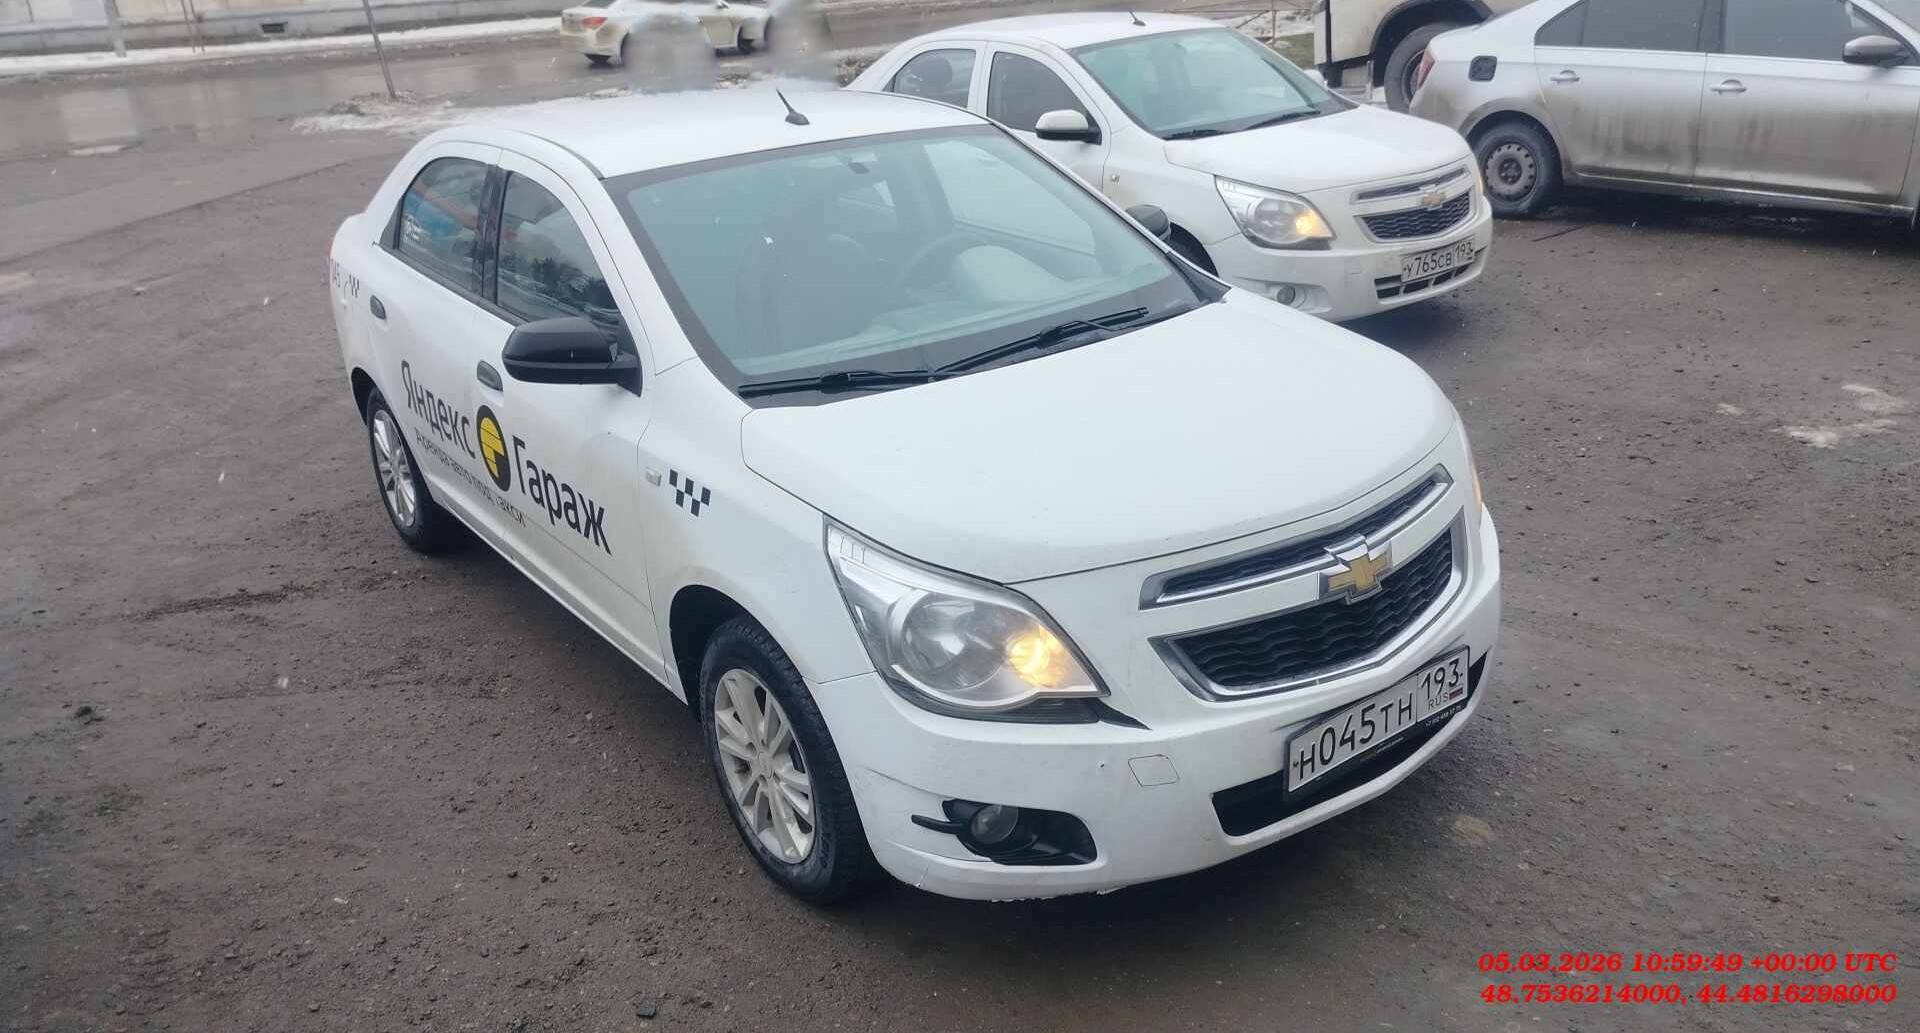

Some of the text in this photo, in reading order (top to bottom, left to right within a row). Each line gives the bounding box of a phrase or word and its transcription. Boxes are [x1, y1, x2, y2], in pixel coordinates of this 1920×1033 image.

[401, 360, 612, 557] Яндекс Гараж
[1299, 657, 1461, 780] Н045ТН 193
[1428, 691, 1450, 711] RUS
